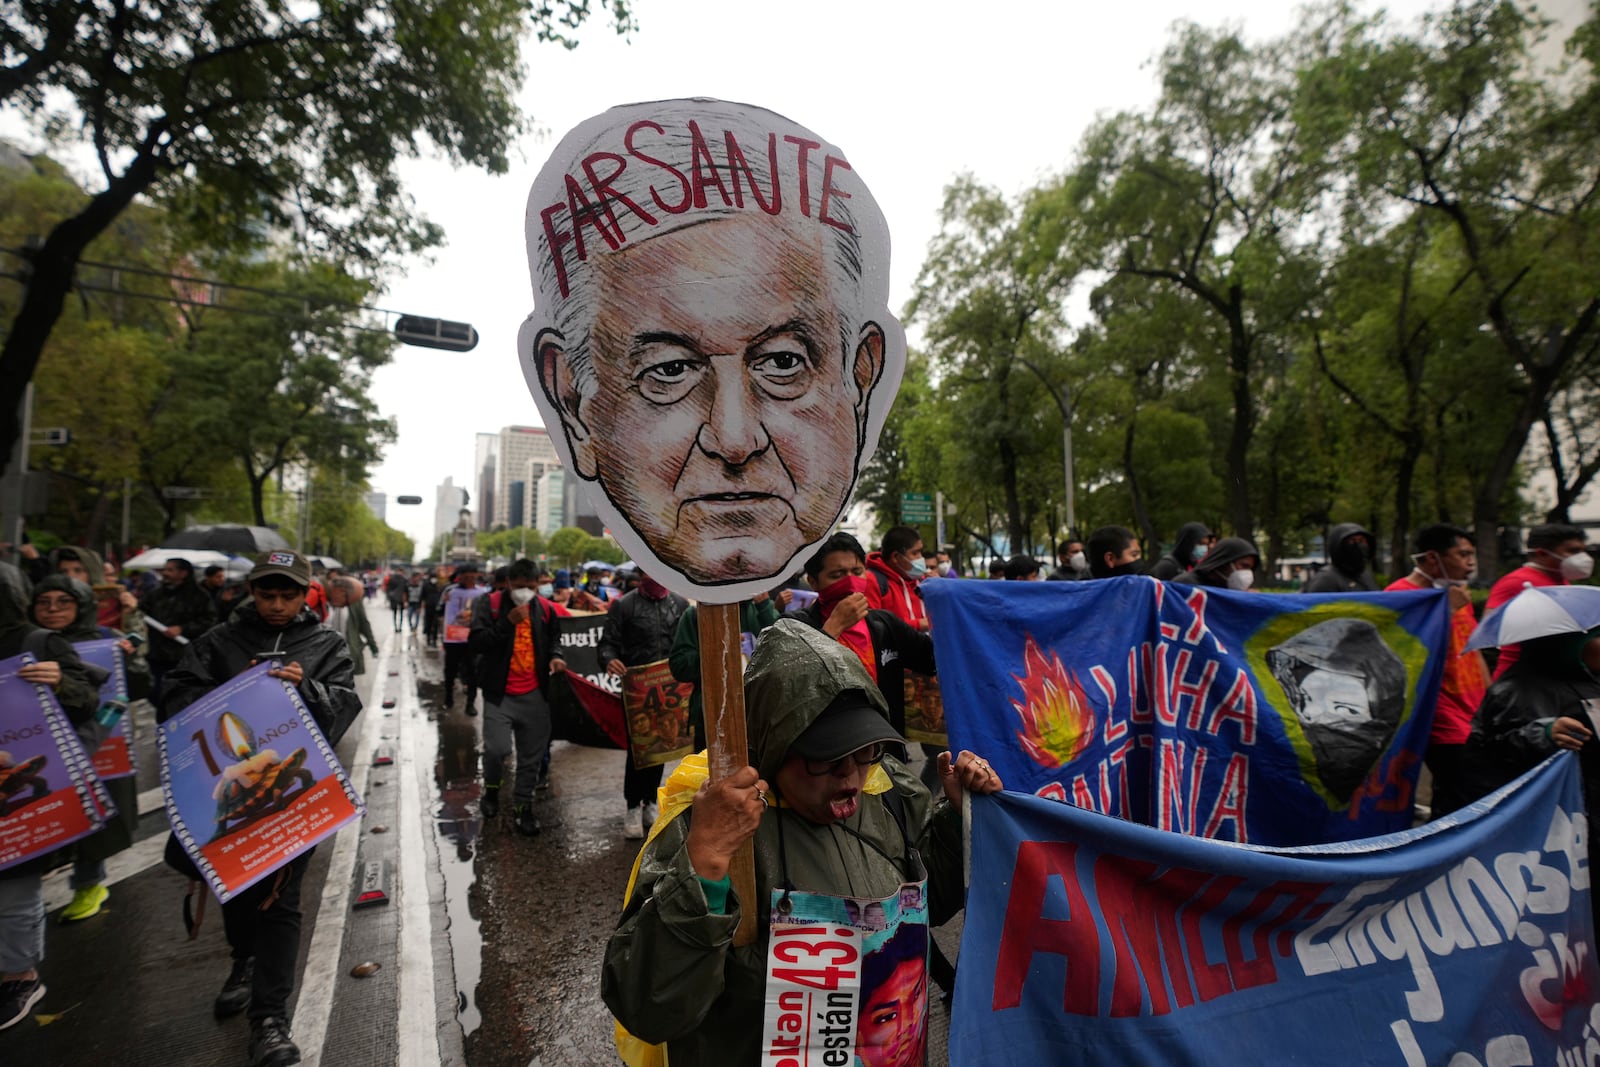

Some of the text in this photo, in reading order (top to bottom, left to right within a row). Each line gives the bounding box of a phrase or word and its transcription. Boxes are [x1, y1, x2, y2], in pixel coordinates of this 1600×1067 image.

[541, 119, 853, 298] FARSANTE
[1089, 641, 1258, 746] LUCHA
[257, 718, 298, 747] AÑOS
[771, 927, 859, 991] 43!
[817, 992, 853, 1067] están
